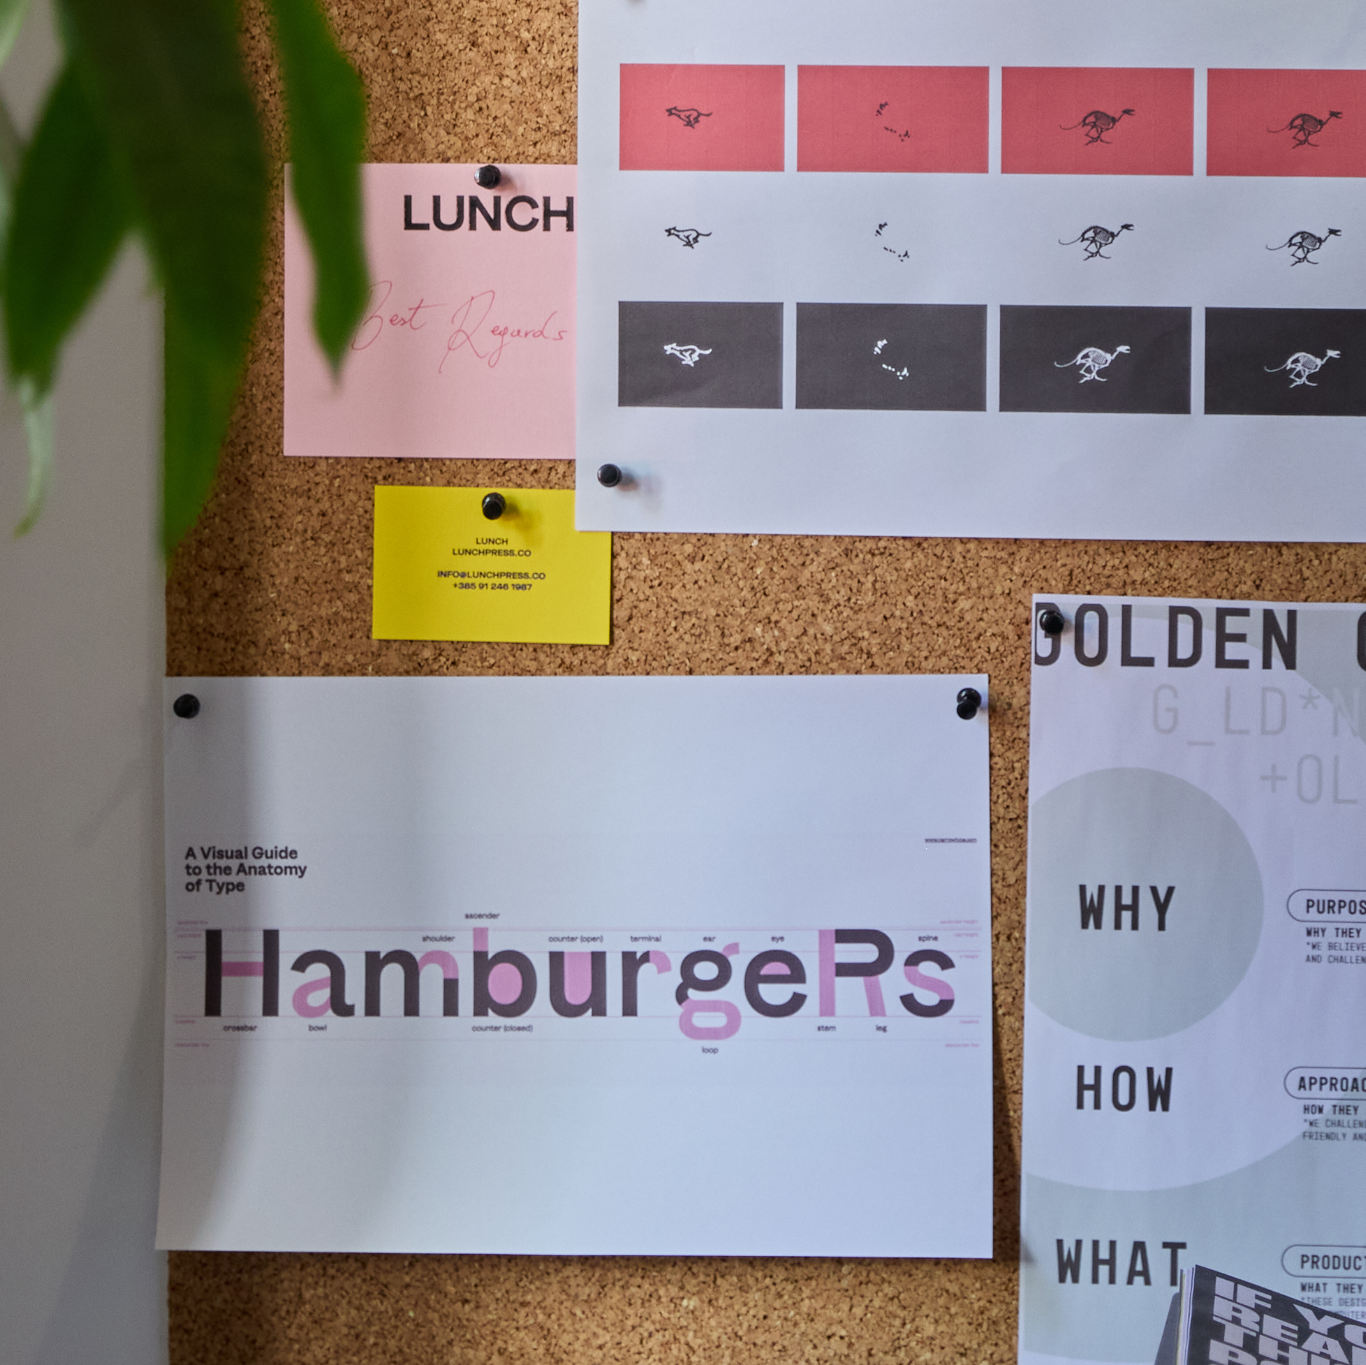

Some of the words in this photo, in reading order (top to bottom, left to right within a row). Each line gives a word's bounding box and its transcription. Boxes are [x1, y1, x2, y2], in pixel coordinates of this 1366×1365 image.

[404, 195, 574, 232] LUNCH
[453, 548, 531, 556] LUNCHPRESS.CO
[437, 570, 545, 579] INFO@LUNCHPRESS.CO
[185, 847, 196, 859] A
[200, 846, 247, 859] Visual
[251, 846, 297, 859] Guide
[185, 864, 202, 876] to
[205, 863, 232, 876] the
[236, 863, 307, 879] Anatomy
[185, 879, 202, 892] of
[205, 879, 245, 895] Type
[1079, 884, 1176, 932] WHY
[1307, 928, 1326, 937] WHY
[1335, 928, 1361, 938] THEY
[1328, 942, 1366, 951] BELIEVE
[1306, 955, 1322, 963] AND
[205, 927, 956, 1041] HamburgeRs
[1076, 1064, 1173, 1112] HOW
[1304, 1105, 1323, 1114] HOW
[1333, 1105, 1358, 1115] THEY
[1055, 1237, 1187, 1286] WHAT
[1215, 1276, 1273, 1309] IF
[1301, 1283, 1327, 1292] WHAT
[1337, 1283, 1362, 1293] THEY
